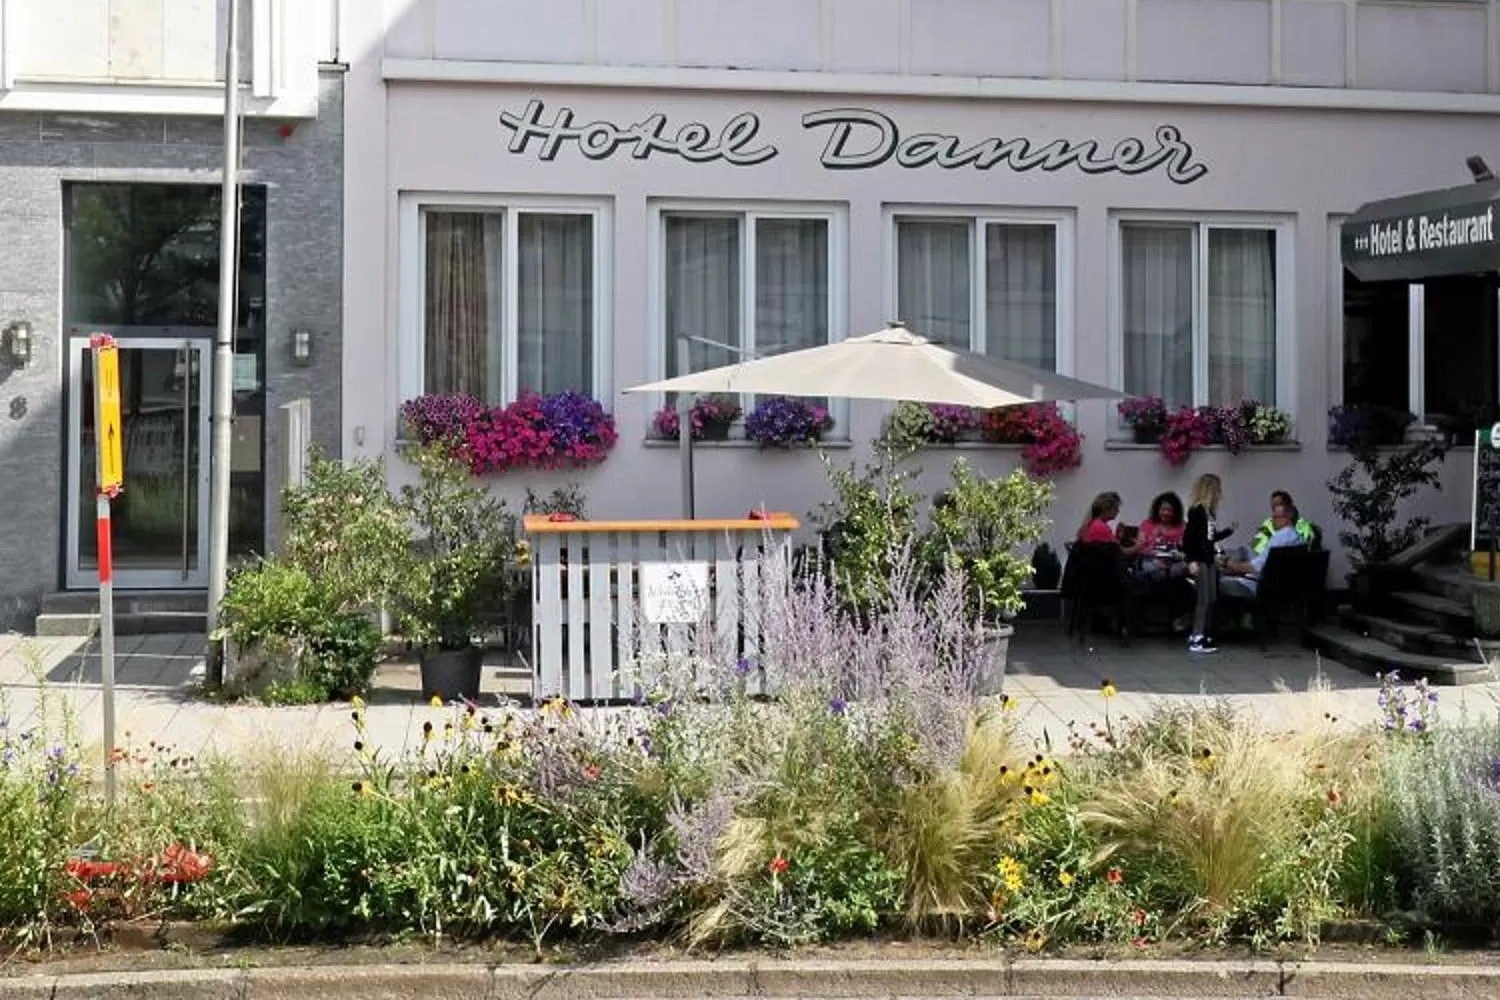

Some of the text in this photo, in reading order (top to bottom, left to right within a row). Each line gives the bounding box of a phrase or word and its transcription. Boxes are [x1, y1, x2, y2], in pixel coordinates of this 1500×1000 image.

[500, 100, 1208, 184] Hotel Danner
[1370, 204, 1494, 257] Hotel & Restaurant
